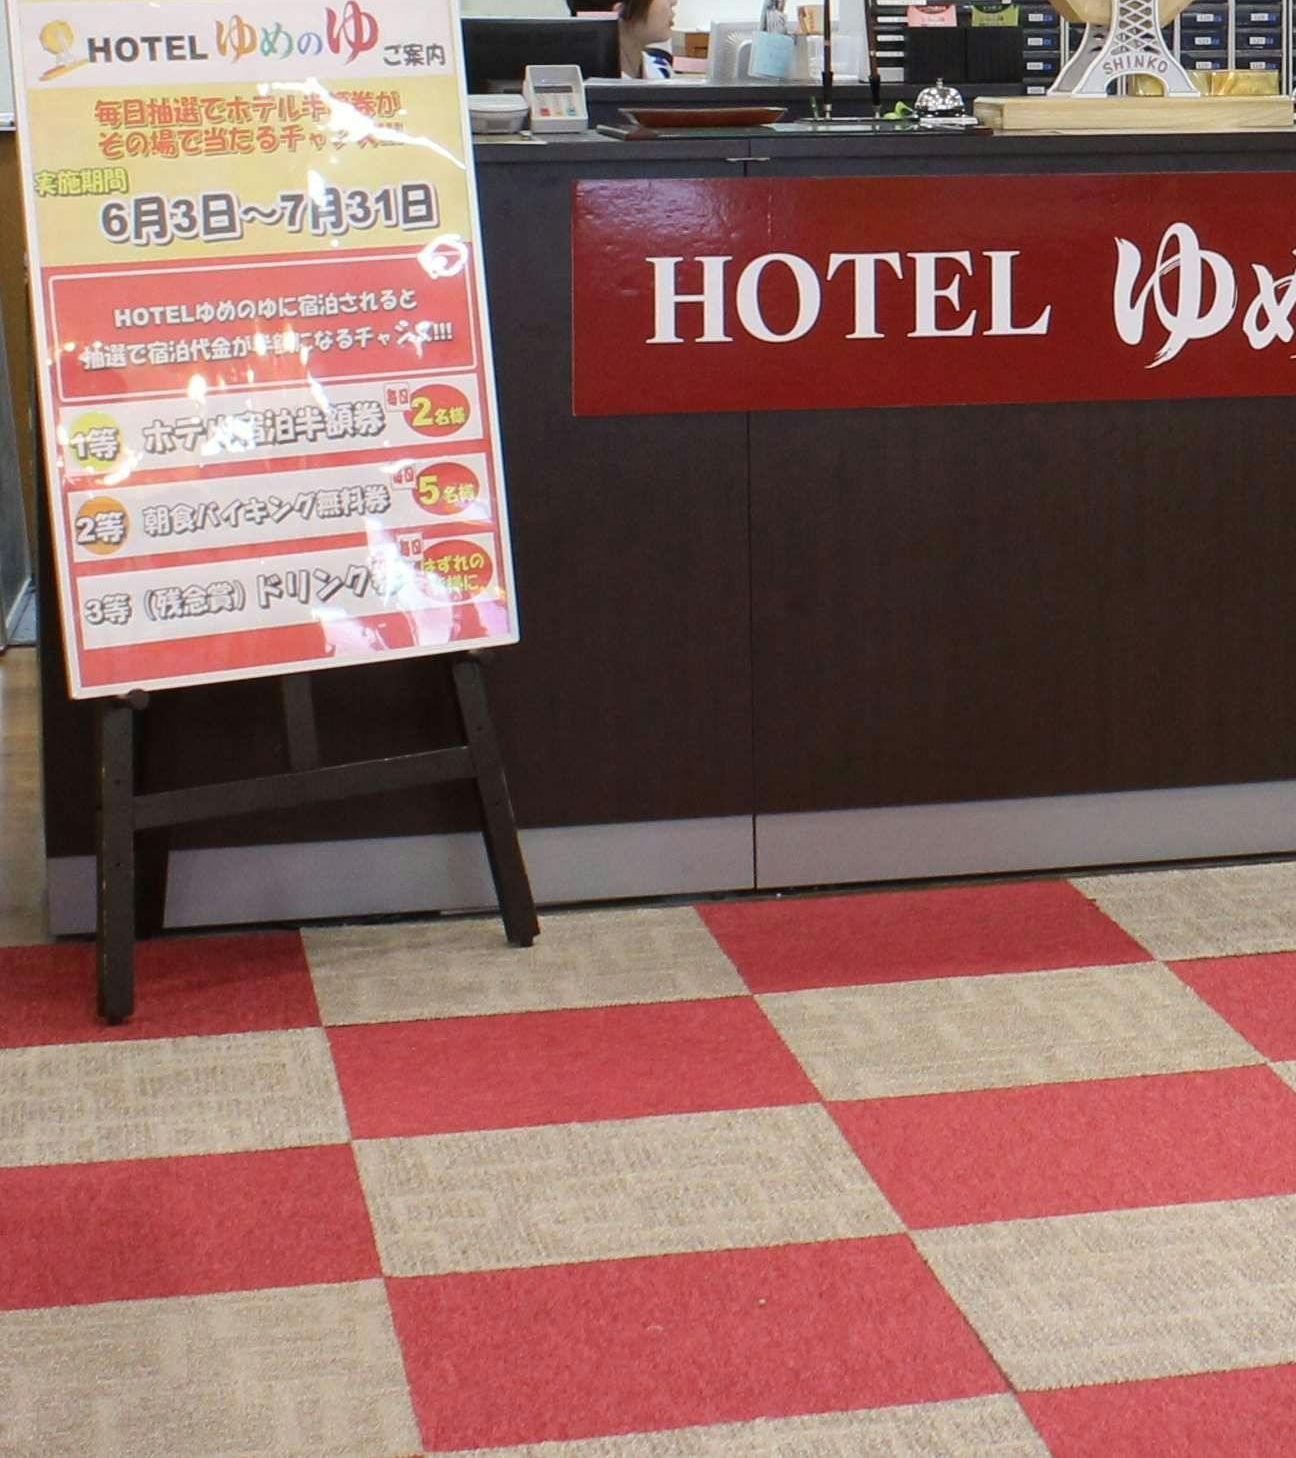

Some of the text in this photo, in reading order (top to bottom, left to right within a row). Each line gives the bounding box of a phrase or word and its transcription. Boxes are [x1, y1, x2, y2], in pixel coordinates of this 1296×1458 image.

[87, 0, 448, 68] HOTEL ゆめのゆ ご案内
[1102, 56, 1168, 76] SHINKO
[94, 90, 402, 130] 毎日抽選でホテル半券が
[34, 167, 129, 198] 実施期間
[645, 250, 1052, 344] HOTEL
[69, 427, 119, 461] 1等
[75, 512, 126, 543] 2等
[84, 594, 132, 626] 3等
